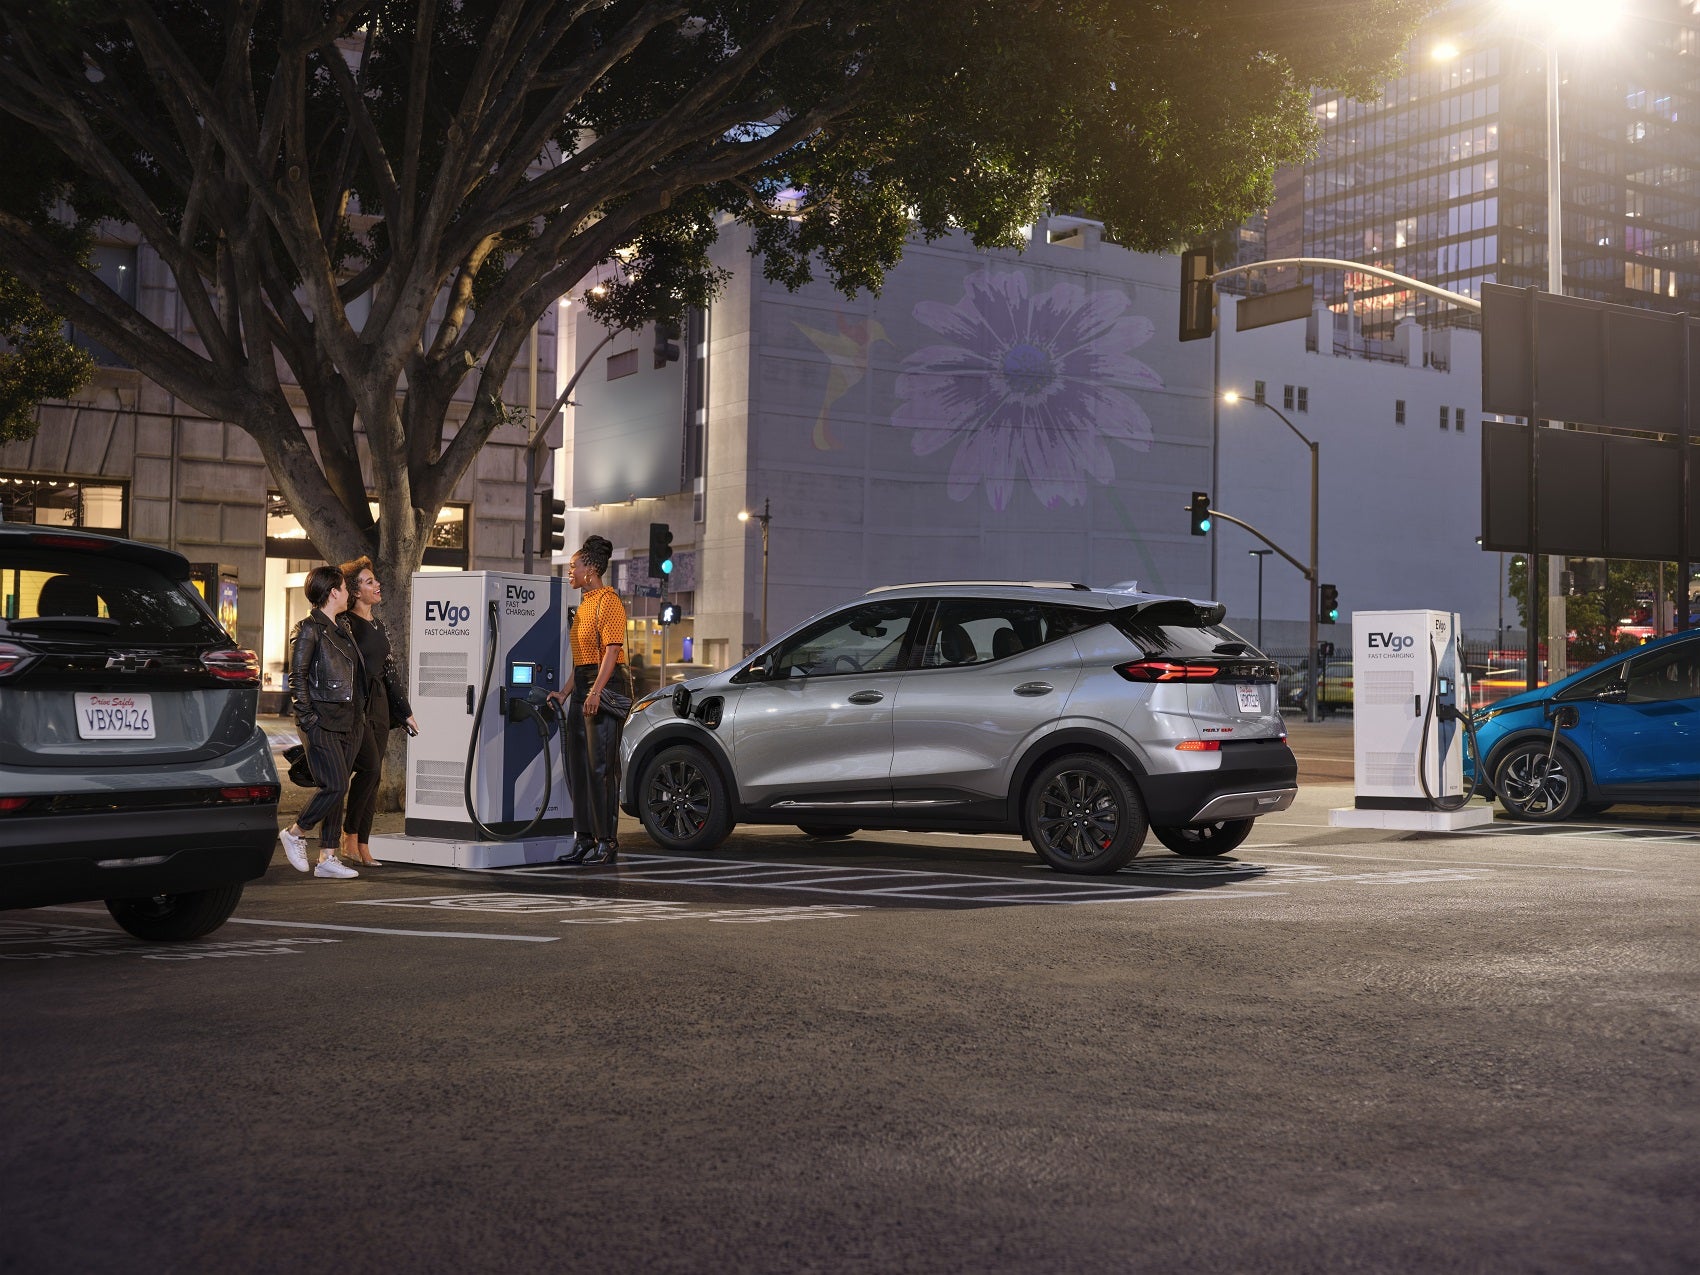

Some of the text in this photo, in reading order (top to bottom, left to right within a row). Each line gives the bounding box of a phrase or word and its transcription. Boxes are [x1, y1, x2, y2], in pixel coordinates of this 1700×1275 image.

[506, 585, 535, 603] EVgo
[425, 600, 470, 627] EVgo
[1435, 619, 1446, 633] EVgo
[1368, 632, 1414, 651] EVgo
[90, 696, 135, 708] Drive Safely
[85, 709, 149, 730] VBX9426
[535, 805, 559, 813] ev.com
